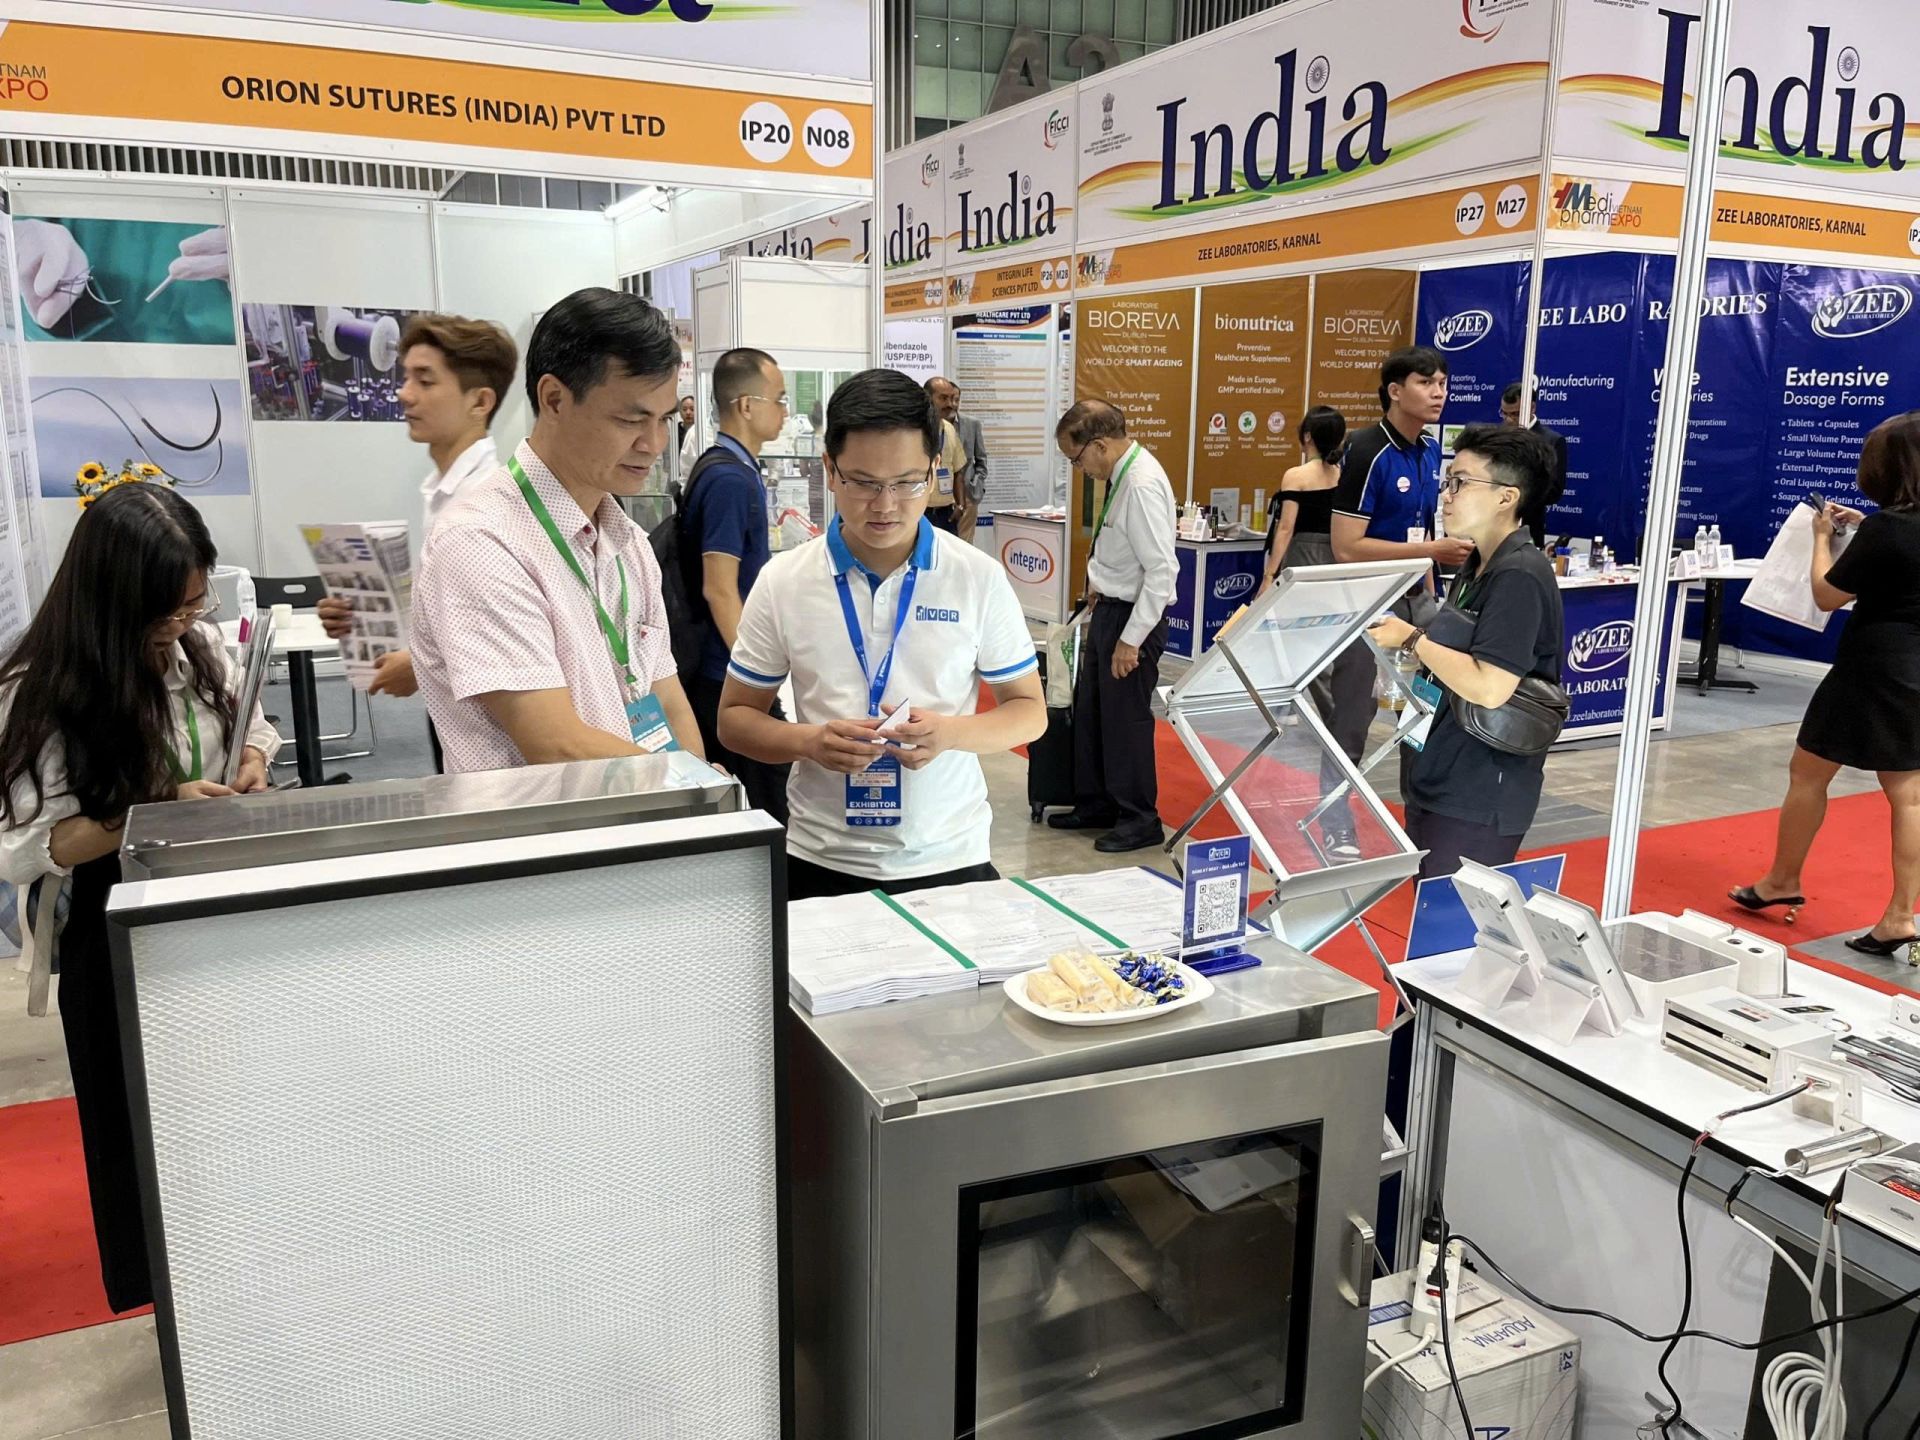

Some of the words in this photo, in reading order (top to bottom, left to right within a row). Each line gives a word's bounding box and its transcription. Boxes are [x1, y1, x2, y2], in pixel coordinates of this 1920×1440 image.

[0, 64, 47, 79] TNAM
[1645, 8, 1906, 172] India
[222, 75, 321, 105] ORION
[328, 84, 457, 118] SUTURES
[464, 97, 558, 131] (INDIA)
[566, 107, 614, 134] PVT
[621, 114, 666, 138] LTD
[1049, 115, 1070, 133] FICCI
[1153, 48, 1392, 211] India
[740, 120, 790, 145] IP20
[807, 126, 849, 149] N08
[926, 159, 940, 174] FICCI
[958, 171, 1057, 253] India
[1496, 197, 1526, 216] M27
[1456, 204, 1484, 223] IP27
[1611, 214, 1642, 228] EXPO
[1717, 208, 1738, 224] ZEE
[1739, 211, 1824, 233] LABORATORIES,
[1825, 218, 1867, 236] KARNAL
[862, 204, 931, 266] Idia
[1198, 247, 1213, 261] ZEE
[1214, 239, 1280, 258] LABORATORIES,
[1282, 233, 1321, 250] KARNAL
[996, 269, 1021, 282] INTEGRIN
[1021, 267, 1033, 278] LIFE
[1040, 270, 1053, 281] IP26
[1056, 268, 1069, 280] M28
[992, 284, 1017, 298] SCIENCES
[1017, 283, 1027, 295] PVT
[1027, 281, 1039, 293] LTD
[1846, 293, 1897, 316] ZEE
[1009, 311, 1020, 319] PVT
[1088, 310, 1181, 331] BIOREVA
[1537, 307, 1564, 328] EE
[1215, 312, 1295, 333] bionutrica
[1324, 317, 1402, 336] BIOREVA
[1454, 315, 1485, 332] ZEE
[884, 342, 928, 351] lbendazole
[1101, 344, 1140, 354] WELCOME
[1140, 345, 1152, 354] TO
[1153, 345, 1168, 355] THE
[1236, 343, 1272, 352] Preventive
[1214, 353, 1250, 363] Healthcare
[1250, 354, 1292, 364] Supplements
[1334, 349, 1367, 359] WELCOME
[1368, 350, 1377, 358] TO
[1085, 357, 1113, 367] WORLD
[1114, 358, 1124, 366] OF
[1125, 358, 1151, 368] SMART
[1153, 359, 1184, 368] AGEING
[1319, 360, 1343, 369] WORLD
[1343, 360, 1353, 369] OF
[1354, 360, 1376, 370] SMART
[1227, 375, 1246, 384] Made
[1247, 375, 1253, 383] in
[1254, 375, 1277, 386] Europe
[1450, 375, 1476, 385] Exporting
[1540, 374, 1614, 389] Manufacturing
[1785, 365, 1890, 388] Extensive
[1106, 390, 1118, 399] The
[1119, 390, 1139, 399] Smart
[1140, 391, 1161, 402] Ageing
[1217, 385, 1235, 395] GMP
[1235, 385, 1261, 395] certified
[1262, 386, 1285, 396] facility
[1317, 391, 1329, 399] Our
[1538, 390, 1568, 402] Plants
[1449, 393, 1482, 403] Countries
[1783, 391, 1836, 409] Dosage
[1840, 392, 1885, 408] Forms
[1128, 405, 1147, 413] Care
[1147, 404, 1153, 413] &
[1135, 415, 1167, 425] Products
[1538, 418, 1580, 426] maceuticals
[1787, 419, 1815, 428] Tablets
[1824, 419, 1860, 430] Capsules
[1147, 428, 1172, 438] Ireland
[1689, 431, 1709, 441] Drugs
[1787, 434, 1808, 442] Small
[1810, 434, 1839, 444] Volume
[1840, 435, 1864, 445] Paren
[1146, 442, 1158, 451] You
[1783, 448, 1805, 459] Large
[1807, 449, 1836, 459] Volume
[1837, 450, 1861, 460] Paren
[1781, 463, 1815, 473] External
[1815, 465, 1858, 475] Preparatio
[1680, 485, 1703, 494] actams
[1779, 478, 1796, 487] Oral
[1797, 479, 1827, 489] Liquids
[1834, 481, 1849, 491] Dry
[1777, 492, 1801, 502] Soaps
[1552, 504, 1583, 514] Products
[1698, 511, 1719, 522] Soon)
[1010, 547, 1049, 573] integrin
[1230, 576, 1250, 588] ZEE
[926, 609, 959, 622] VCR
[1594, 628, 1631, 650] ZEE
[1593, 646, 1630, 655] LABORATORIES
[849, 801, 897, 809] EXHIBITOR
[1472, 1315, 1537, 1349] AQUAFINA
[1563, 1351, 1573, 1370] 24
